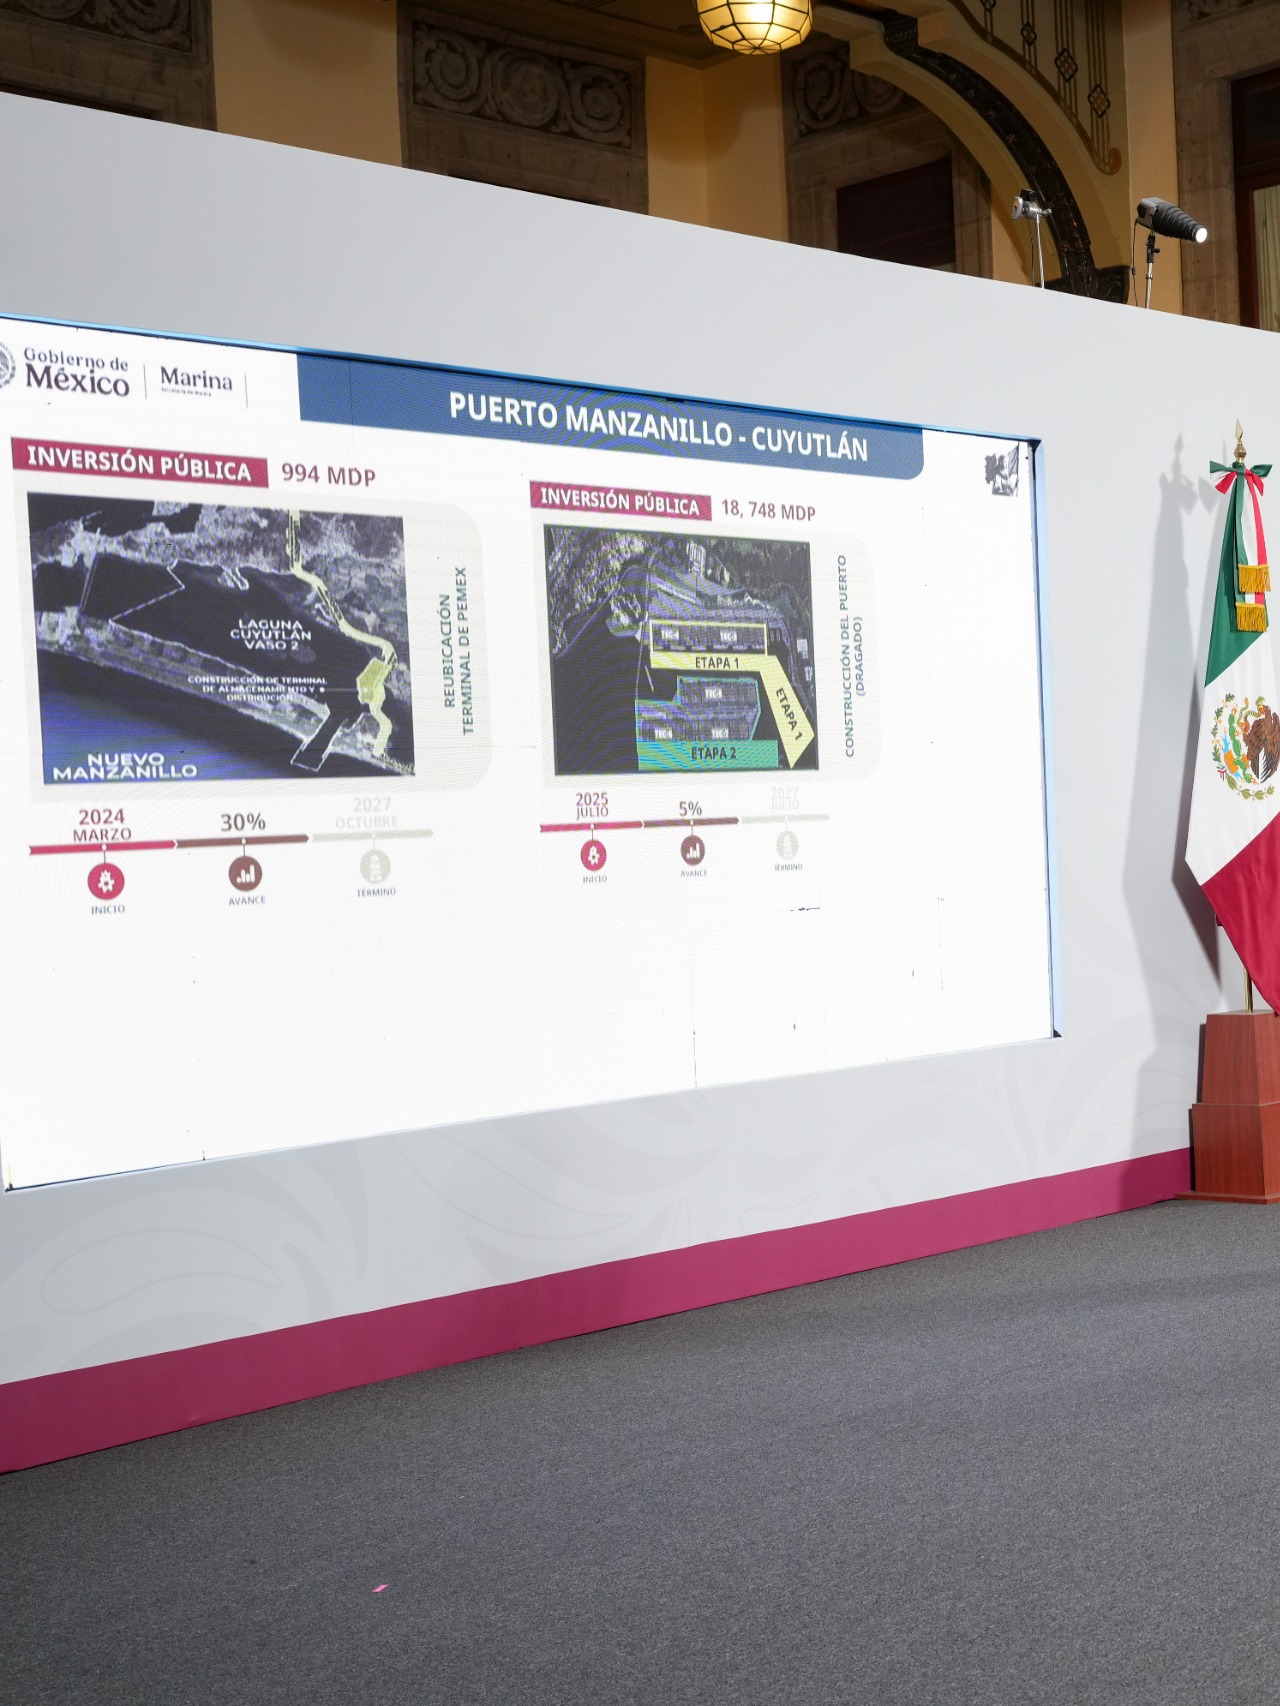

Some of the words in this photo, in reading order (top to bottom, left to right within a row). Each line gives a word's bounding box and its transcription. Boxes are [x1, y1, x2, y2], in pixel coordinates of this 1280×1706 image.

[24, 347, 105, 370] Gobierno
[110, 356, 129, 372] de
[25, 362, 130, 397] México
[160, 366, 233, 391] Marina
[449, 391, 558, 428] PUERTO
[565, 405, 732, 446] MANZANILLO
[751, 425, 868, 461] CUYUTLÁN
[28, 445, 154, 474] INVERSIÓN
[161, 452, 252, 481] PÚBLICA
[281, 462, 320, 483] 994
[327, 465, 376, 487] MDP
[540, 487, 630, 511] INVERSIÓN
[634, 491, 700, 516] PÚBLICA
[781, 503, 816, 522] MDP
[837, 554, 848, 611] PUERTO
[455, 566, 468, 622] PEMEX
[238, 618, 303, 630] LAGUNA
[840, 615, 850, 641] DEL
[244, 639, 287, 650] VASO
[291, 640, 299, 650] 2
[458, 625, 470, 647] DE
[437, 594, 455, 708] REUBICACIÓN
[853, 616, 866, 697] (DRAGADO)
[695, 656, 731, 669] ETAPA
[734, 657, 740, 669] 1
[187, 675, 264, 684] CONSTRUCCIÓN
[268, 676, 279, 684] DE
[280, 676, 328, 685] TERMINAL
[459, 651, 474, 736] TERMINAL
[839, 643, 855, 758] CONSTRUCCIÓN
[774, 686, 799, 732] ETAPA
[87, 752, 165, 768] NUEVO
[691, 747, 730, 760] ETAPA
[730, 747, 737, 759] 2
[53, 764, 198, 781] MANZANILLO
[353, 796, 392, 813] 2027
[576, 791, 609, 807] 2025
[78, 808, 126, 826] 2024
[576, 805, 609, 821] JULIO
[679, 800, 703, 817] 5%
[221, 812, 267, 832] 30%
[335, 814, 399, 830] OCTUBRE
[73, 827, 132, 843] MARZO
[582, 875, 608, 884] INICIO
[680, 869, 708, 878] AVANCE
[228, 895, 266, 906] AVANCE
[357, 886, 397, 898] TÉRMINO
[91, 904, 126, 915] INICIO
